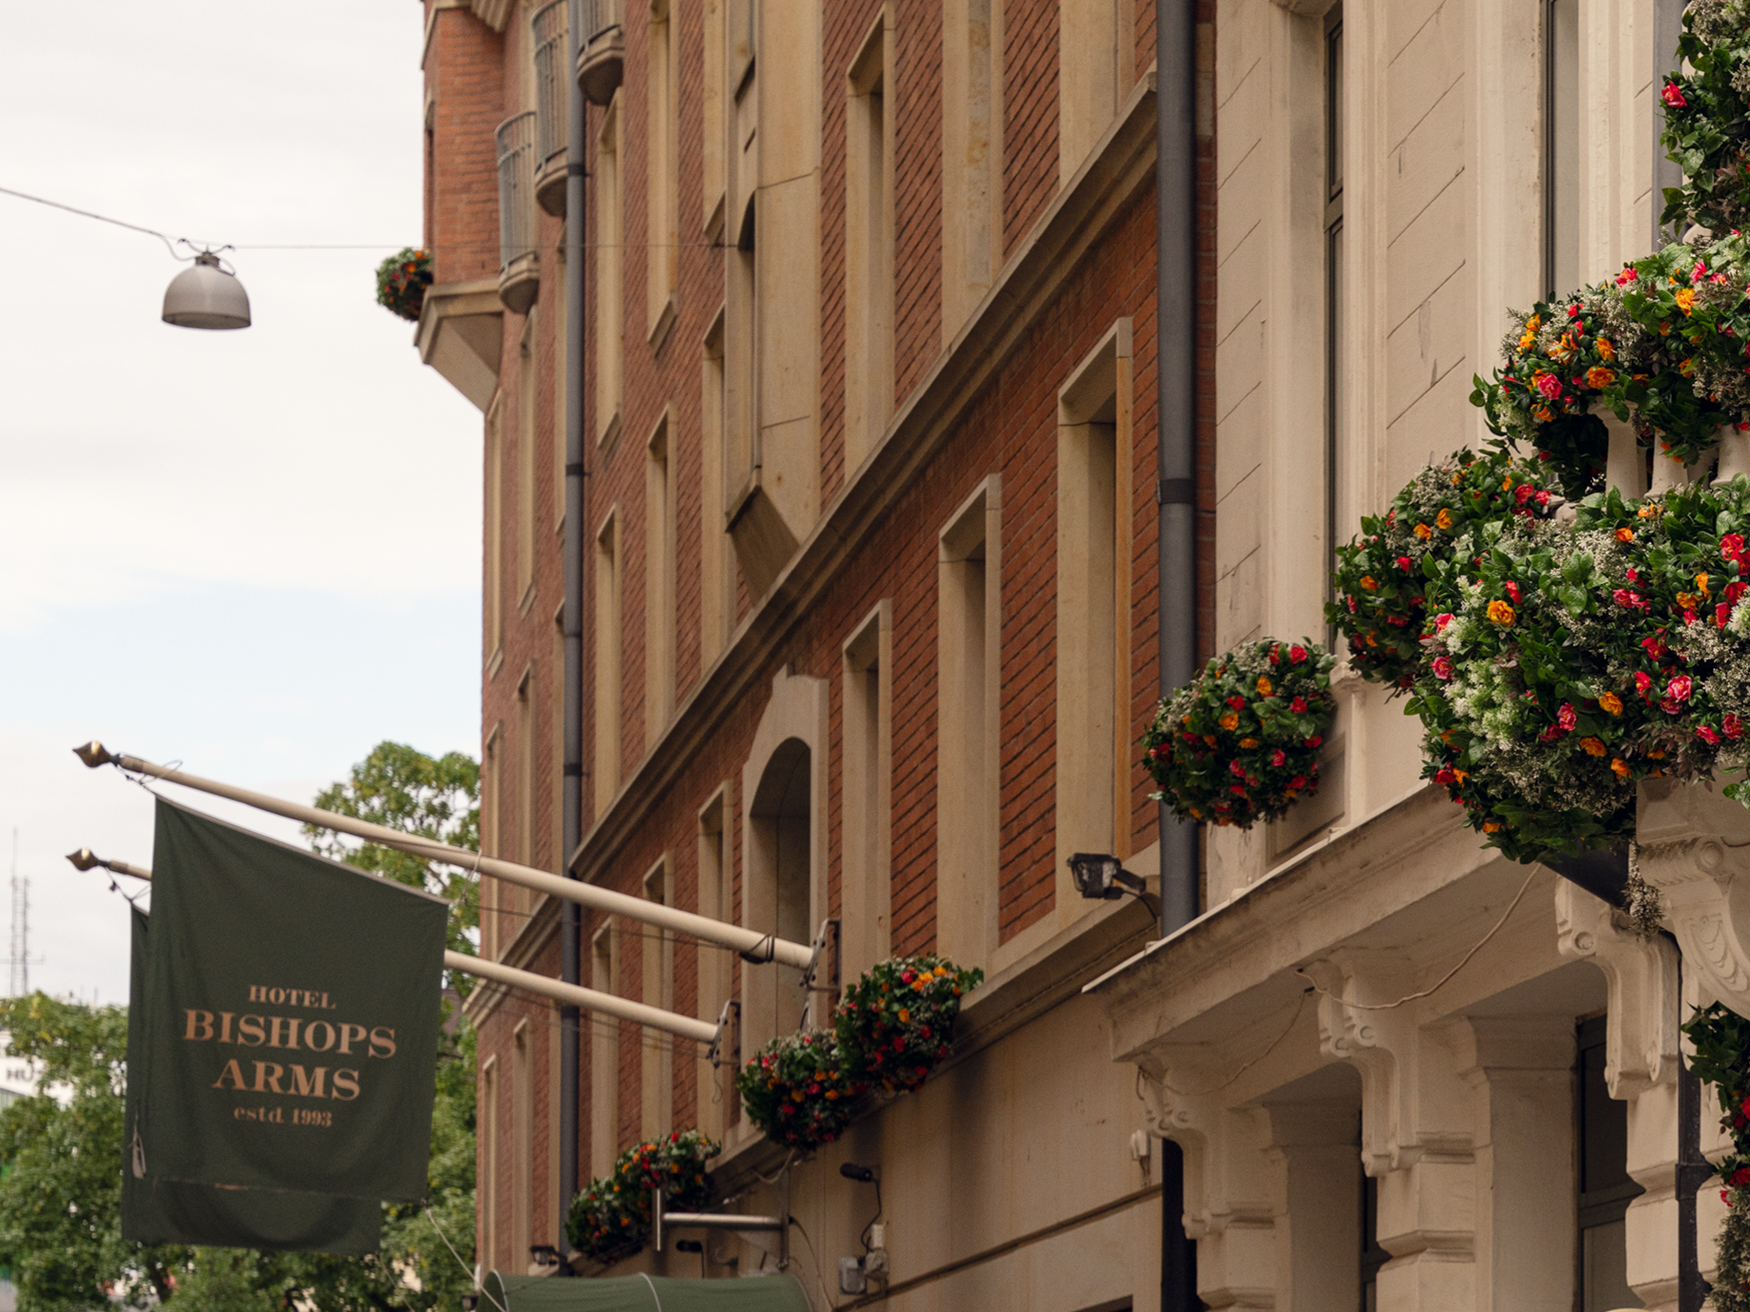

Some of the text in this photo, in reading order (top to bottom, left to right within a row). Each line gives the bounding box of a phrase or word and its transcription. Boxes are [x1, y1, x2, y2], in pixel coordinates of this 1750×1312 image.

[249, 984, 336, 1009] HOTEL
[183, 1008, 397, 1059] BISHOPS
[212, 1058, 360, 1101] ARMS
[292, 1107, 333, 1128] 1993
